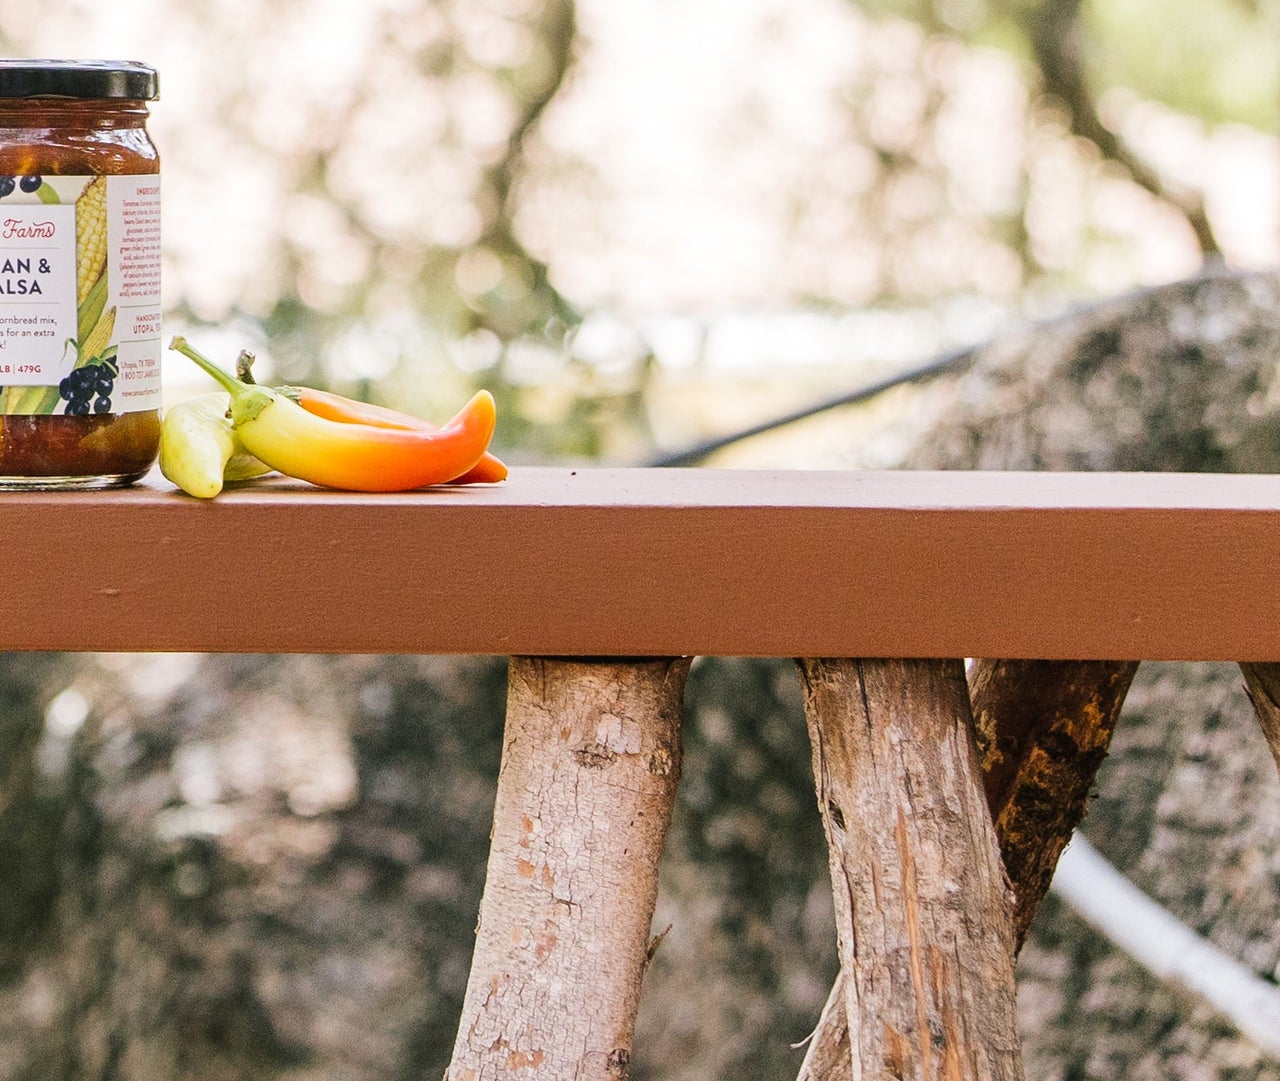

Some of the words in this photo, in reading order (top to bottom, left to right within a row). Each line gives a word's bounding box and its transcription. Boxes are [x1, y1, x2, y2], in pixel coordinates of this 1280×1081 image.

[2, 218, 55, 239] Farms
[38, 258, 51, 274] &
[6, 328, 19, 336] for
[0, 365, 10, 373] LB
[18, 365, 41, 373] 479G
